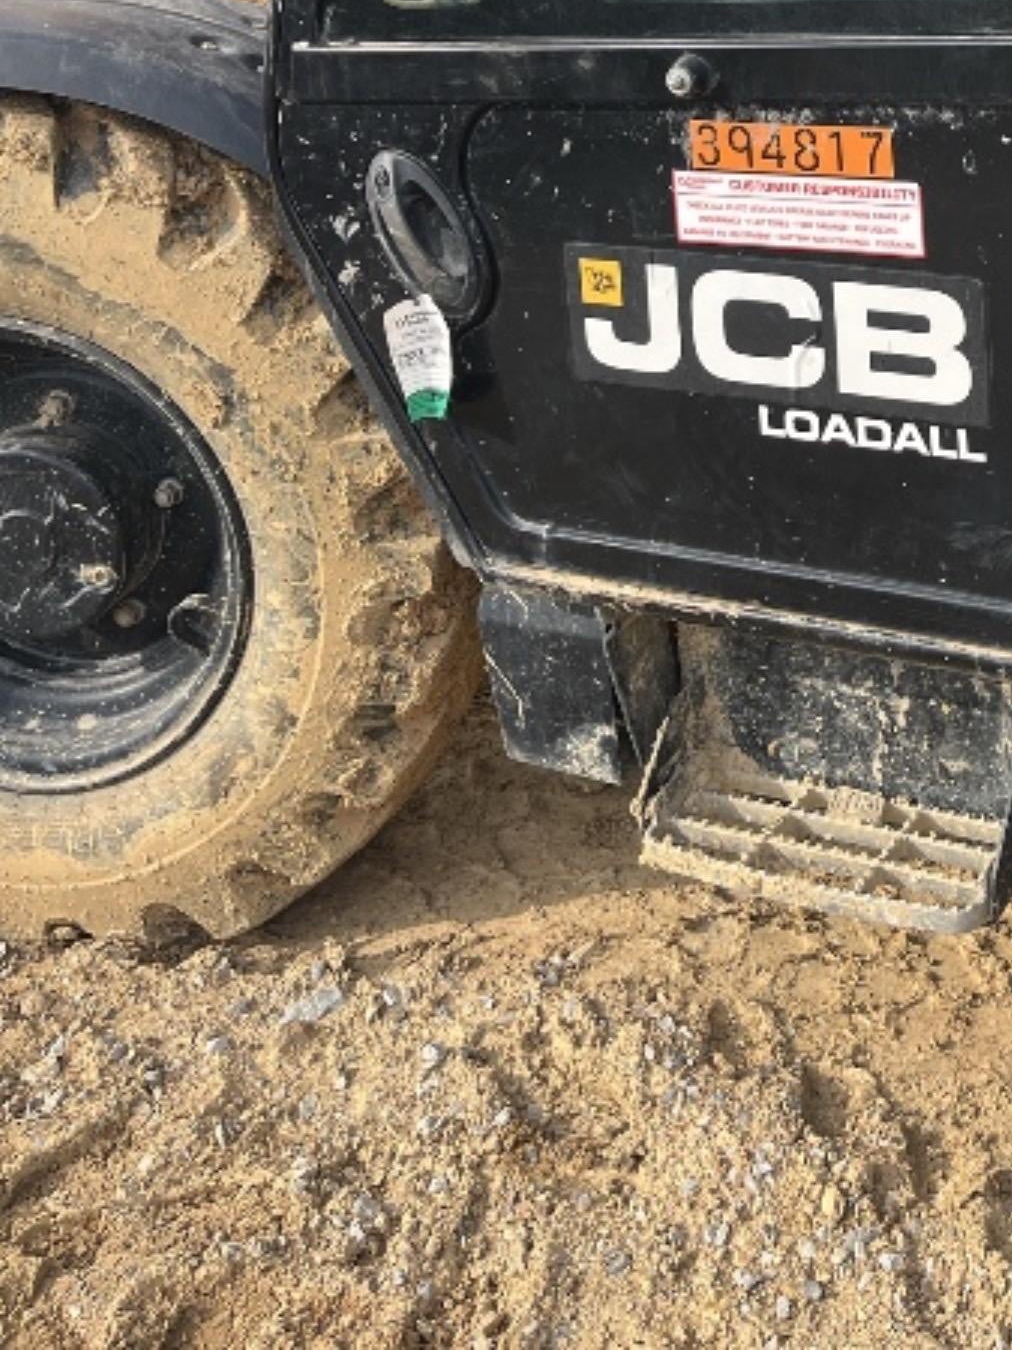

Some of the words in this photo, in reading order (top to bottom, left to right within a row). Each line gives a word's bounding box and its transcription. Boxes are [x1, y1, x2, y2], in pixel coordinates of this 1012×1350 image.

[697, 124, 883, 175] 394817
[584, 263, 973, 406] JCB
[757, 405, 988, 464] LOADALL
